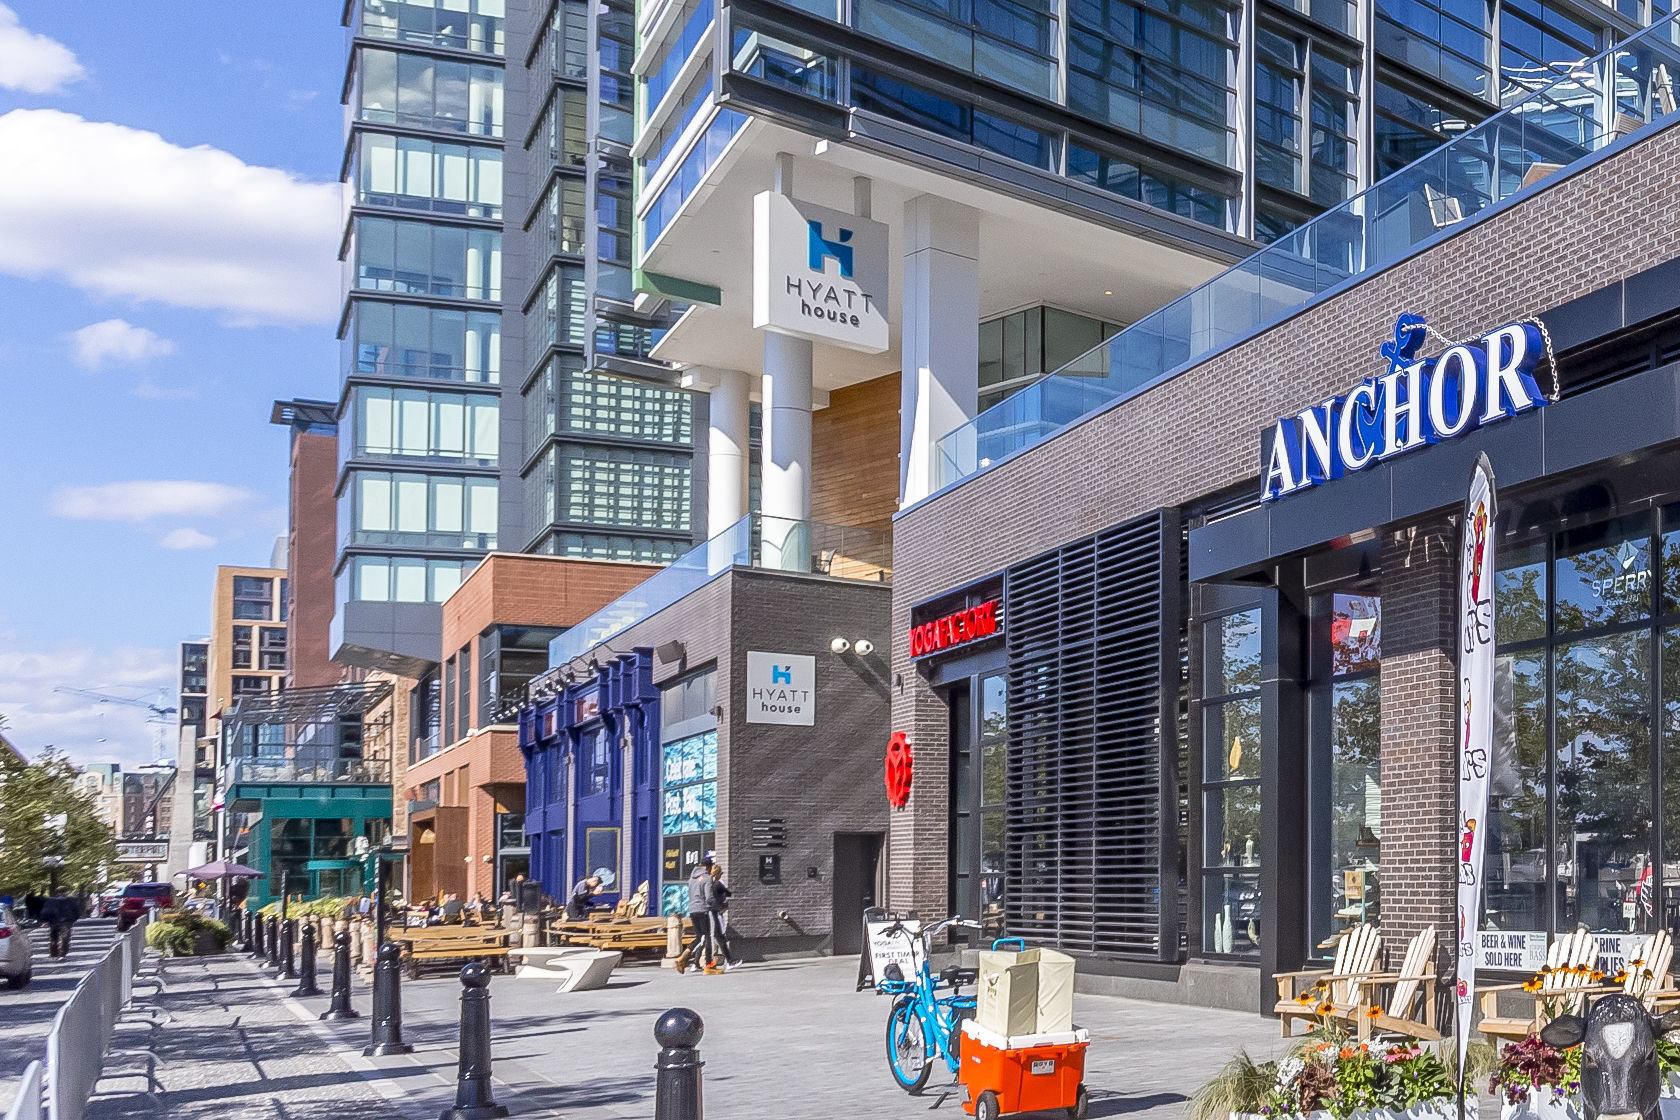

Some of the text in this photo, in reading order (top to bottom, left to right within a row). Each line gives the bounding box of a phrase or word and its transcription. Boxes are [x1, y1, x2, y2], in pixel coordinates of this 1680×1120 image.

[786, 275, 873, 314] HYATT
[801, 298, 860, 327] house
[1260, 321, 1548, 502] ANCHOR
[1592, 570, 1652, 598] SPERR
[753, 688, 809, 703] HYATT
[761, 702, 801, 714] house
[1481, 934, 1499, 949] BEER
[1500, 935, 1507, 949] &
[1507, 935, 1526, 950] WINE
[1595, 937, 1622, 953] RINE
[875, 951, 920, 959] FIRST TIMR
[1485, 952, 1503, 967] SOLD
[1504, 952, 1522, 968] HERE
